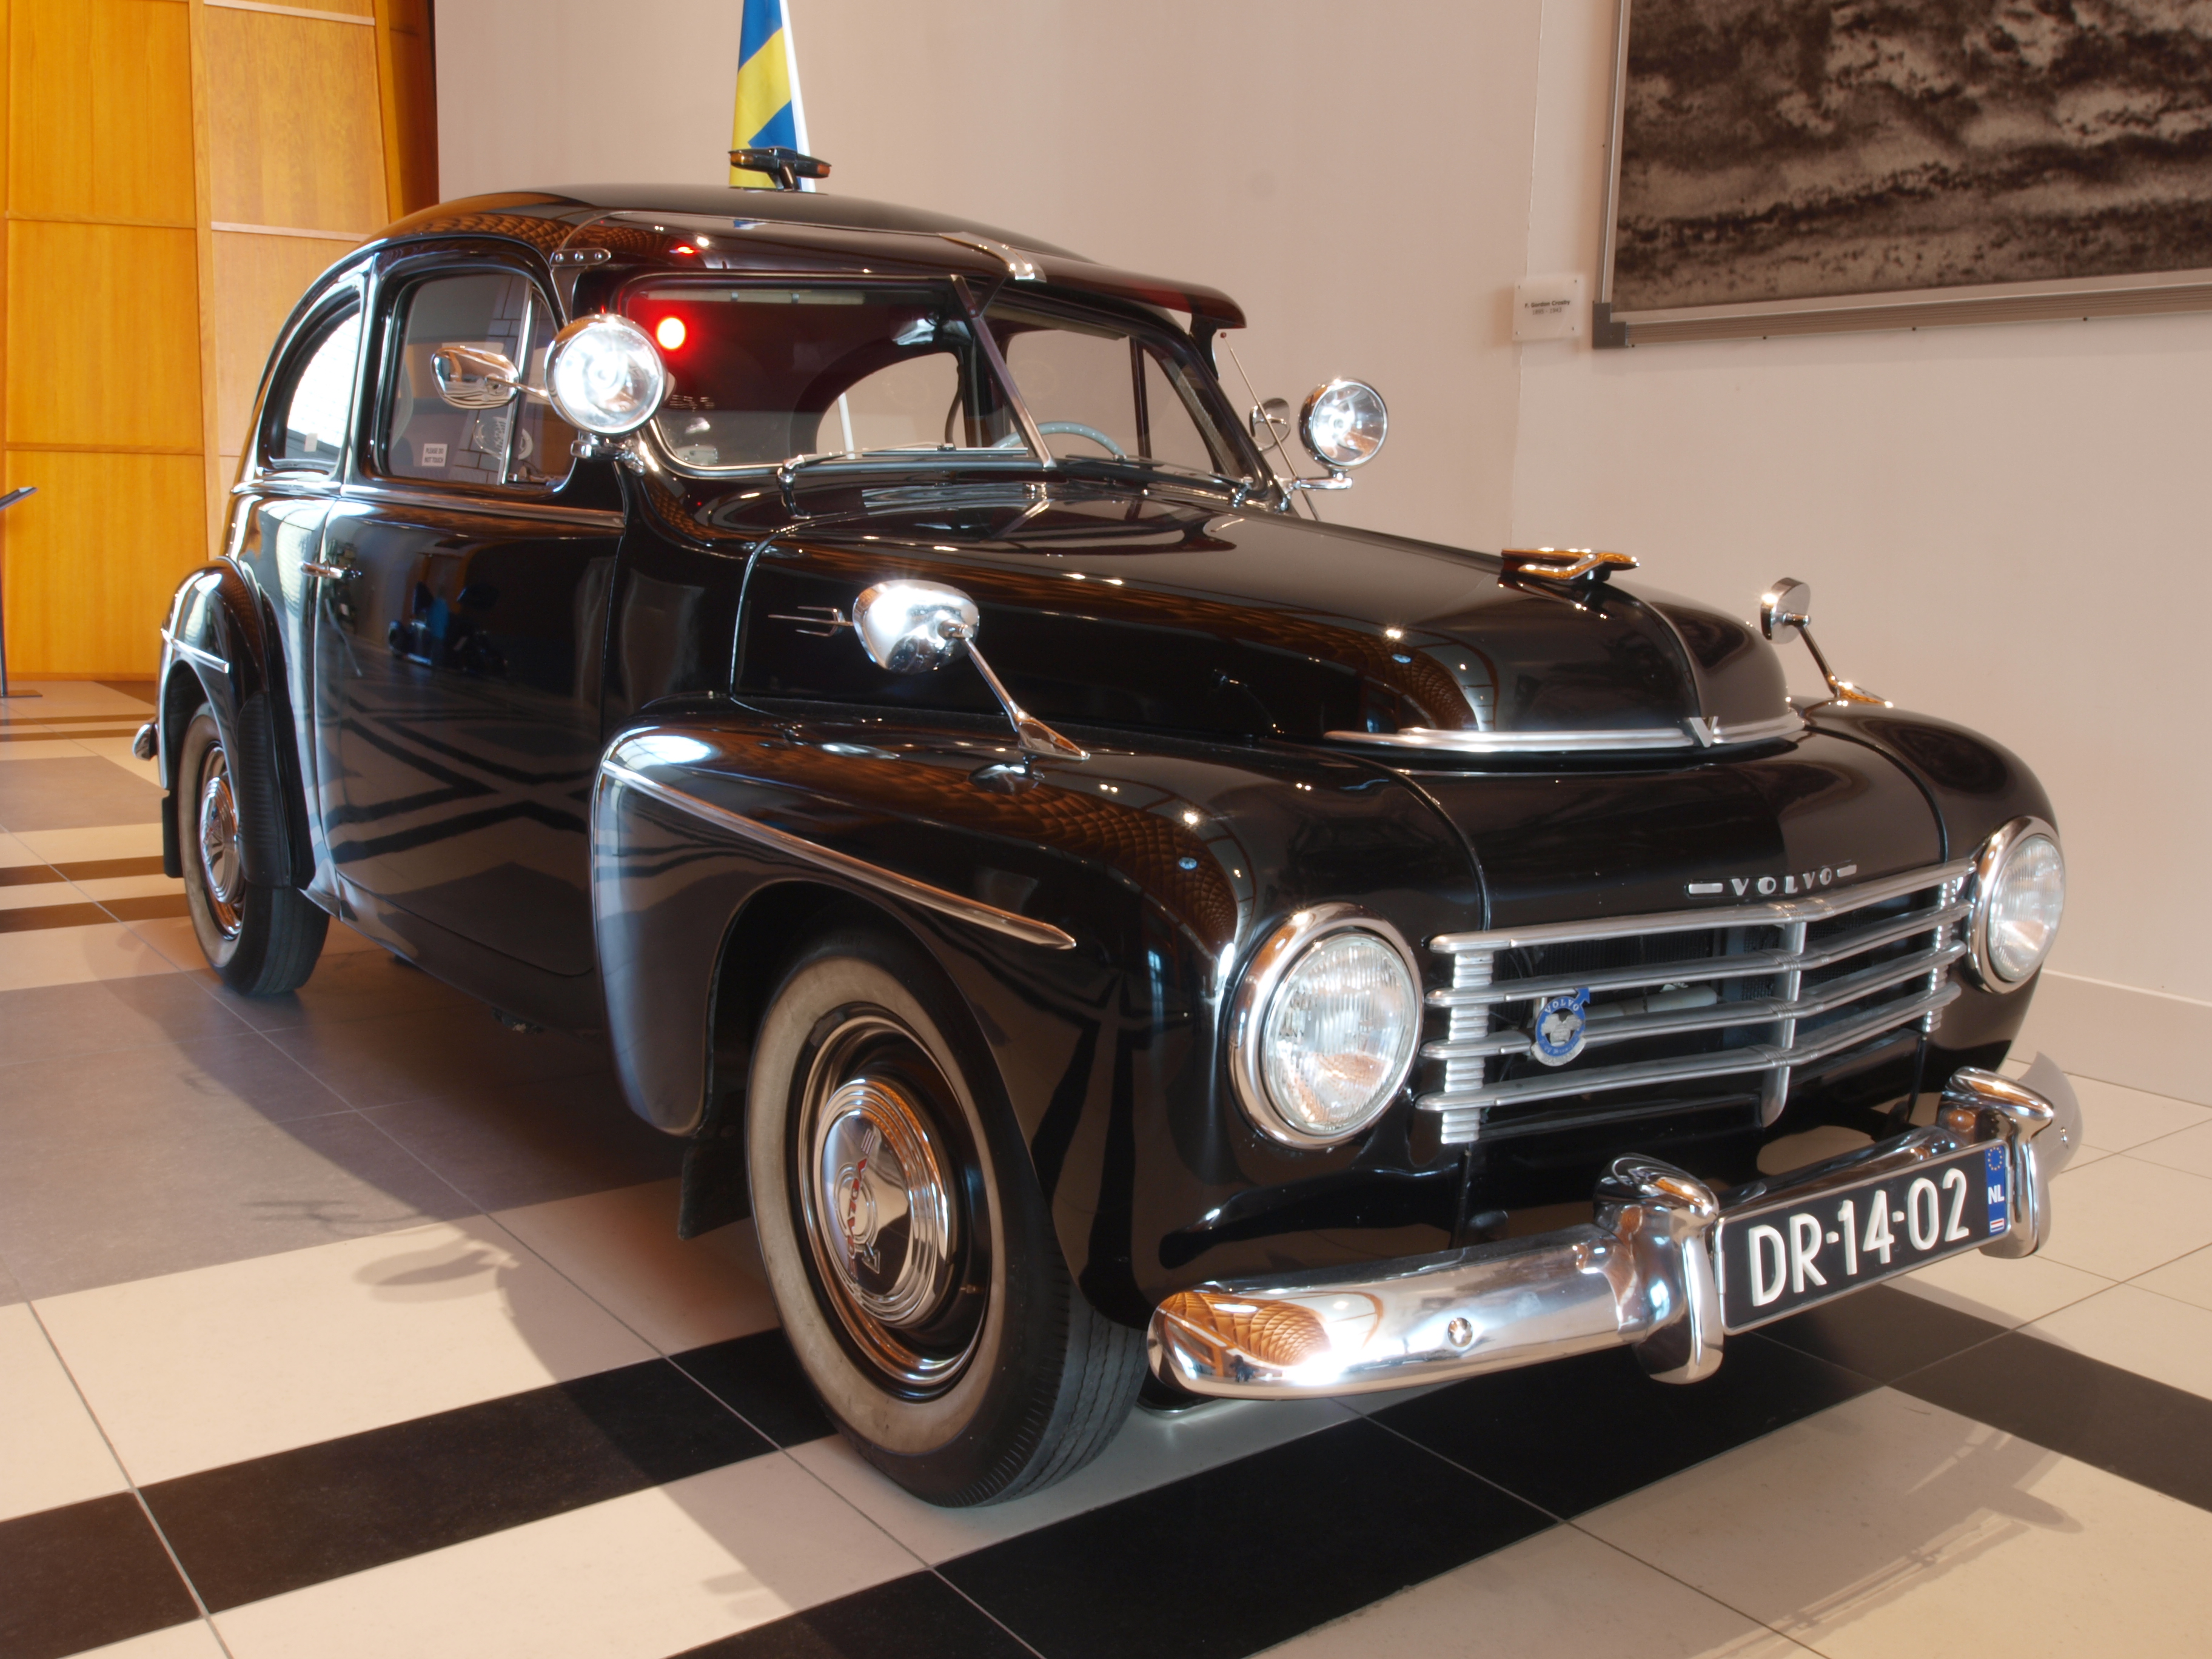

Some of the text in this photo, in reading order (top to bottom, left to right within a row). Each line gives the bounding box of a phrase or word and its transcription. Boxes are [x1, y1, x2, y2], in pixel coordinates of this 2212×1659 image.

[1731, 868, 1832, 896] VOLVO
[1545, 999, 1580, 1013] VOLVO
[847, 1158, 867, 1256] VOLVO
[1988, 1184, 2005, 1205] NL
[1748, 1168, 1969, 1306] DR-14-02
